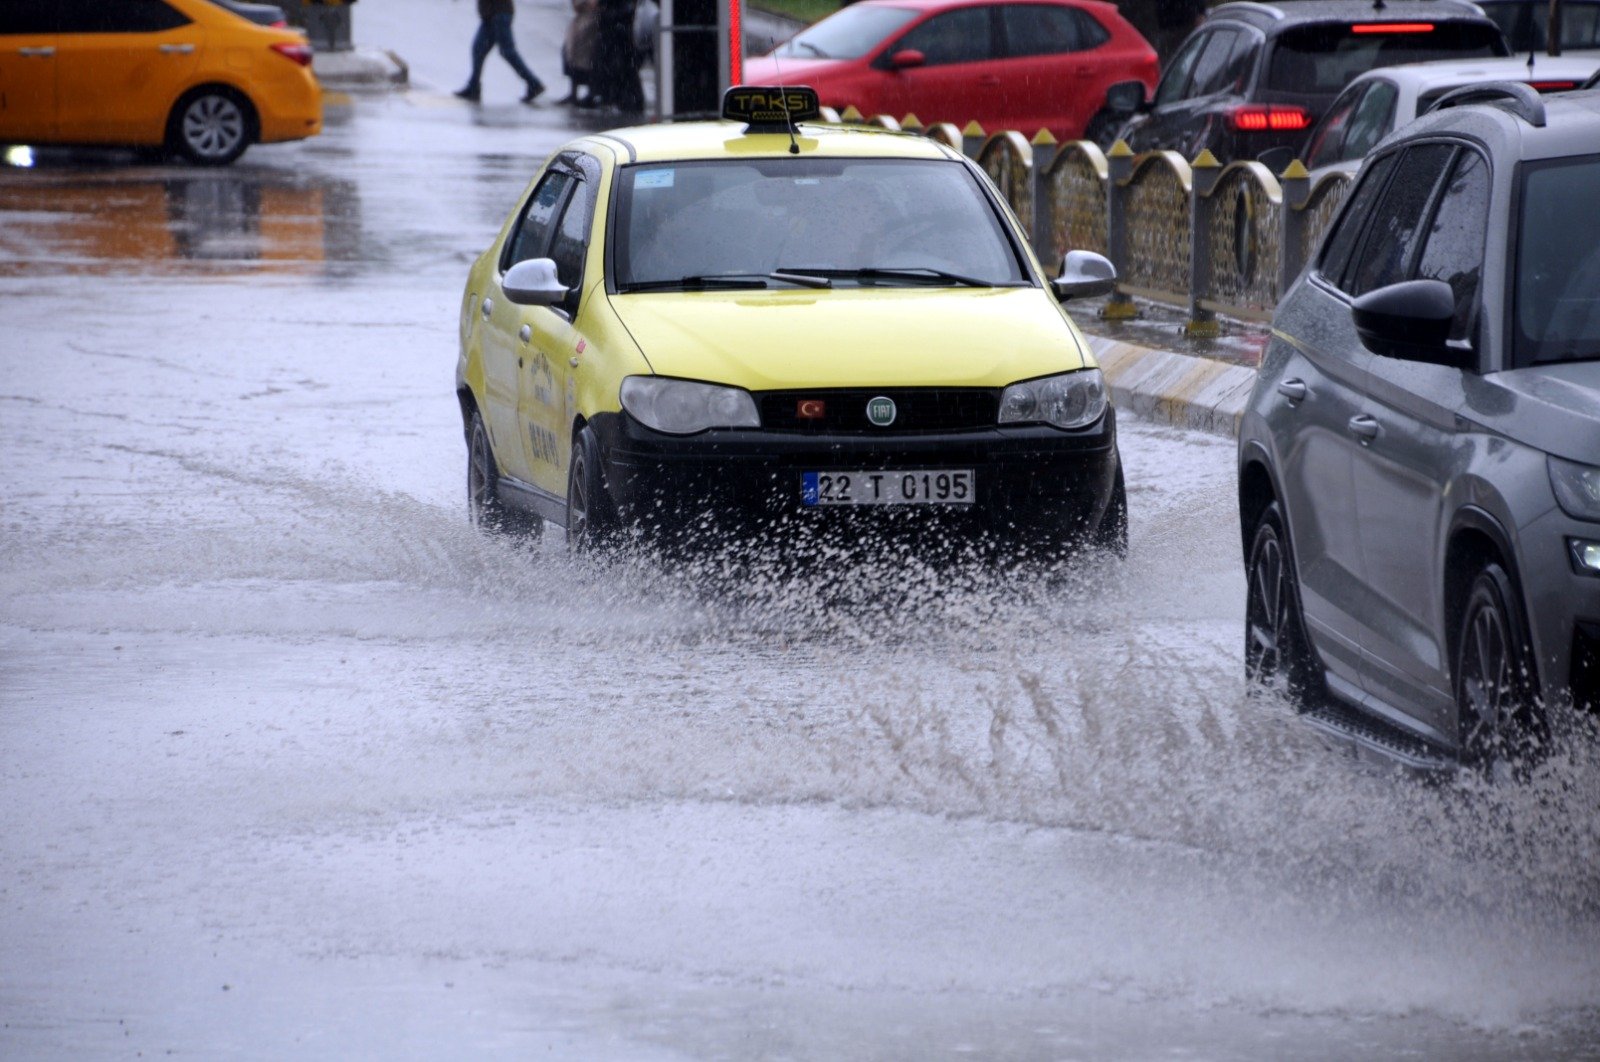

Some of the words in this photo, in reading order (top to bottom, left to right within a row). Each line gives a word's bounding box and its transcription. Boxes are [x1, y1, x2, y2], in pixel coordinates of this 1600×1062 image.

[873, 404, 891, 418] FIAT
[819, 475, 851, 502] 22
[869, 475, 884, 499] T
[902, 473, 968, 500] 0195
